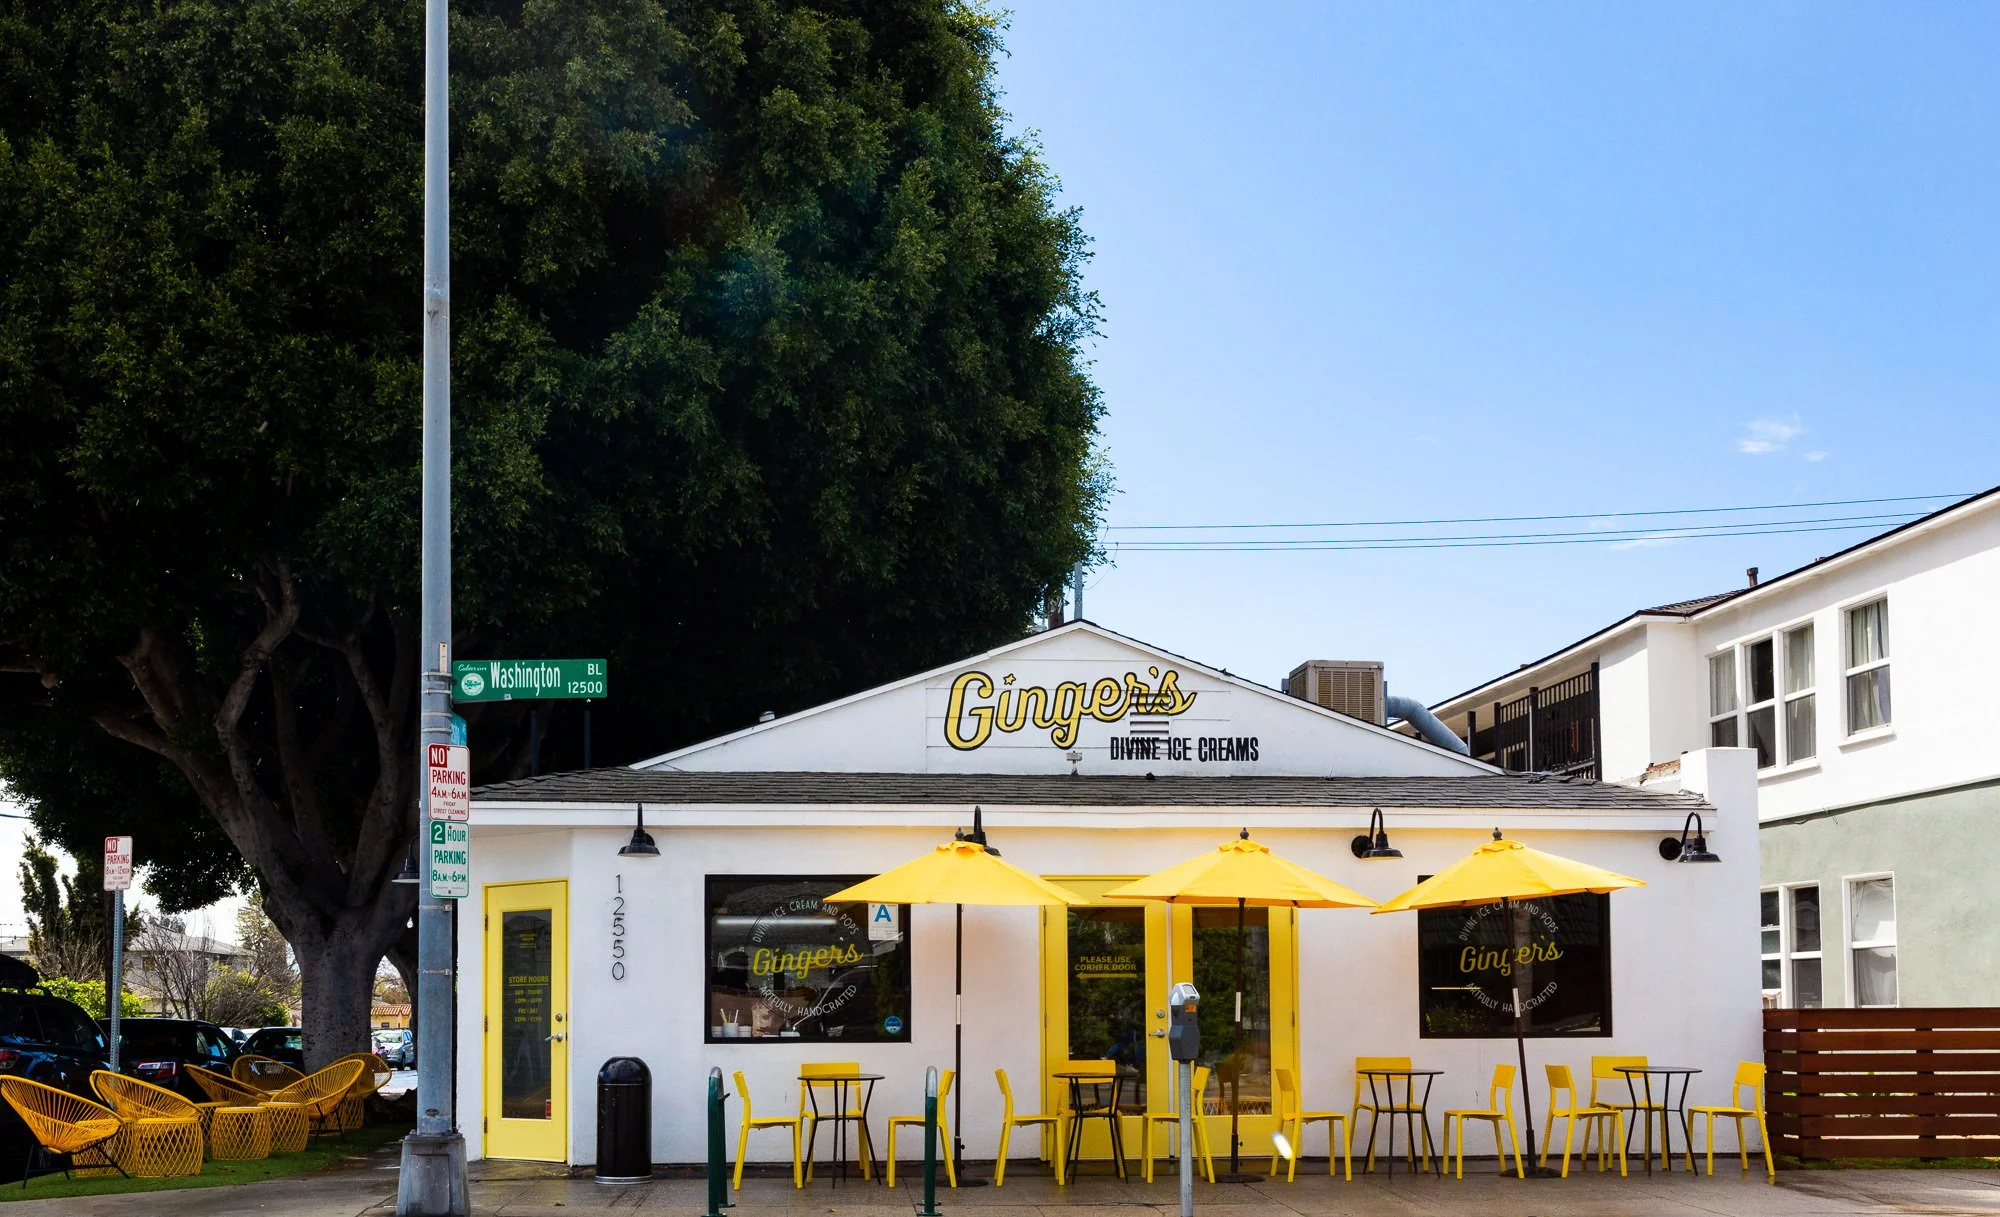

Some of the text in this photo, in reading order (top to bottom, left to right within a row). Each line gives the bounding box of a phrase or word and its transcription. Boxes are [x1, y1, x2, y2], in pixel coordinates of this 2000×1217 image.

[587, 663, 603, 675] BL
[490, 661, 561, 697] Washington
[567, 681, 603, 694] 12500
[944, 666, 1197, 751] Ginger's
[431, 747, 446, 765] NO
[1110, 736, 1259, 762] DIVINE ICE CREAMS
[432, 769, 466, 785] PARKING
[434, 824, 466, 842] 2 HOUR
[107, 839, 116, 852] NO
[107, 854, 129, 864] PARKING
[434, 849, 466, 865] PARKING
[771, 906, 787, 920] ICE
[789, 900, 818, 912] CREAM
[821, 903, 839, 916] AND
[840, 913, 860, 935] POPS
[874, 904, 892, 923] A
[1459, 899, 1559, 941] DIVINE ICE CRAM AND POPS
[612, 874, 625, 980] 12550
[508, 975, 549, 984] STORE HOURS
[760, 984, 857, 1017] ARTFULLY HANDCRAFTED
[1502, 981, 1558, 1012] HADCRAFTED
